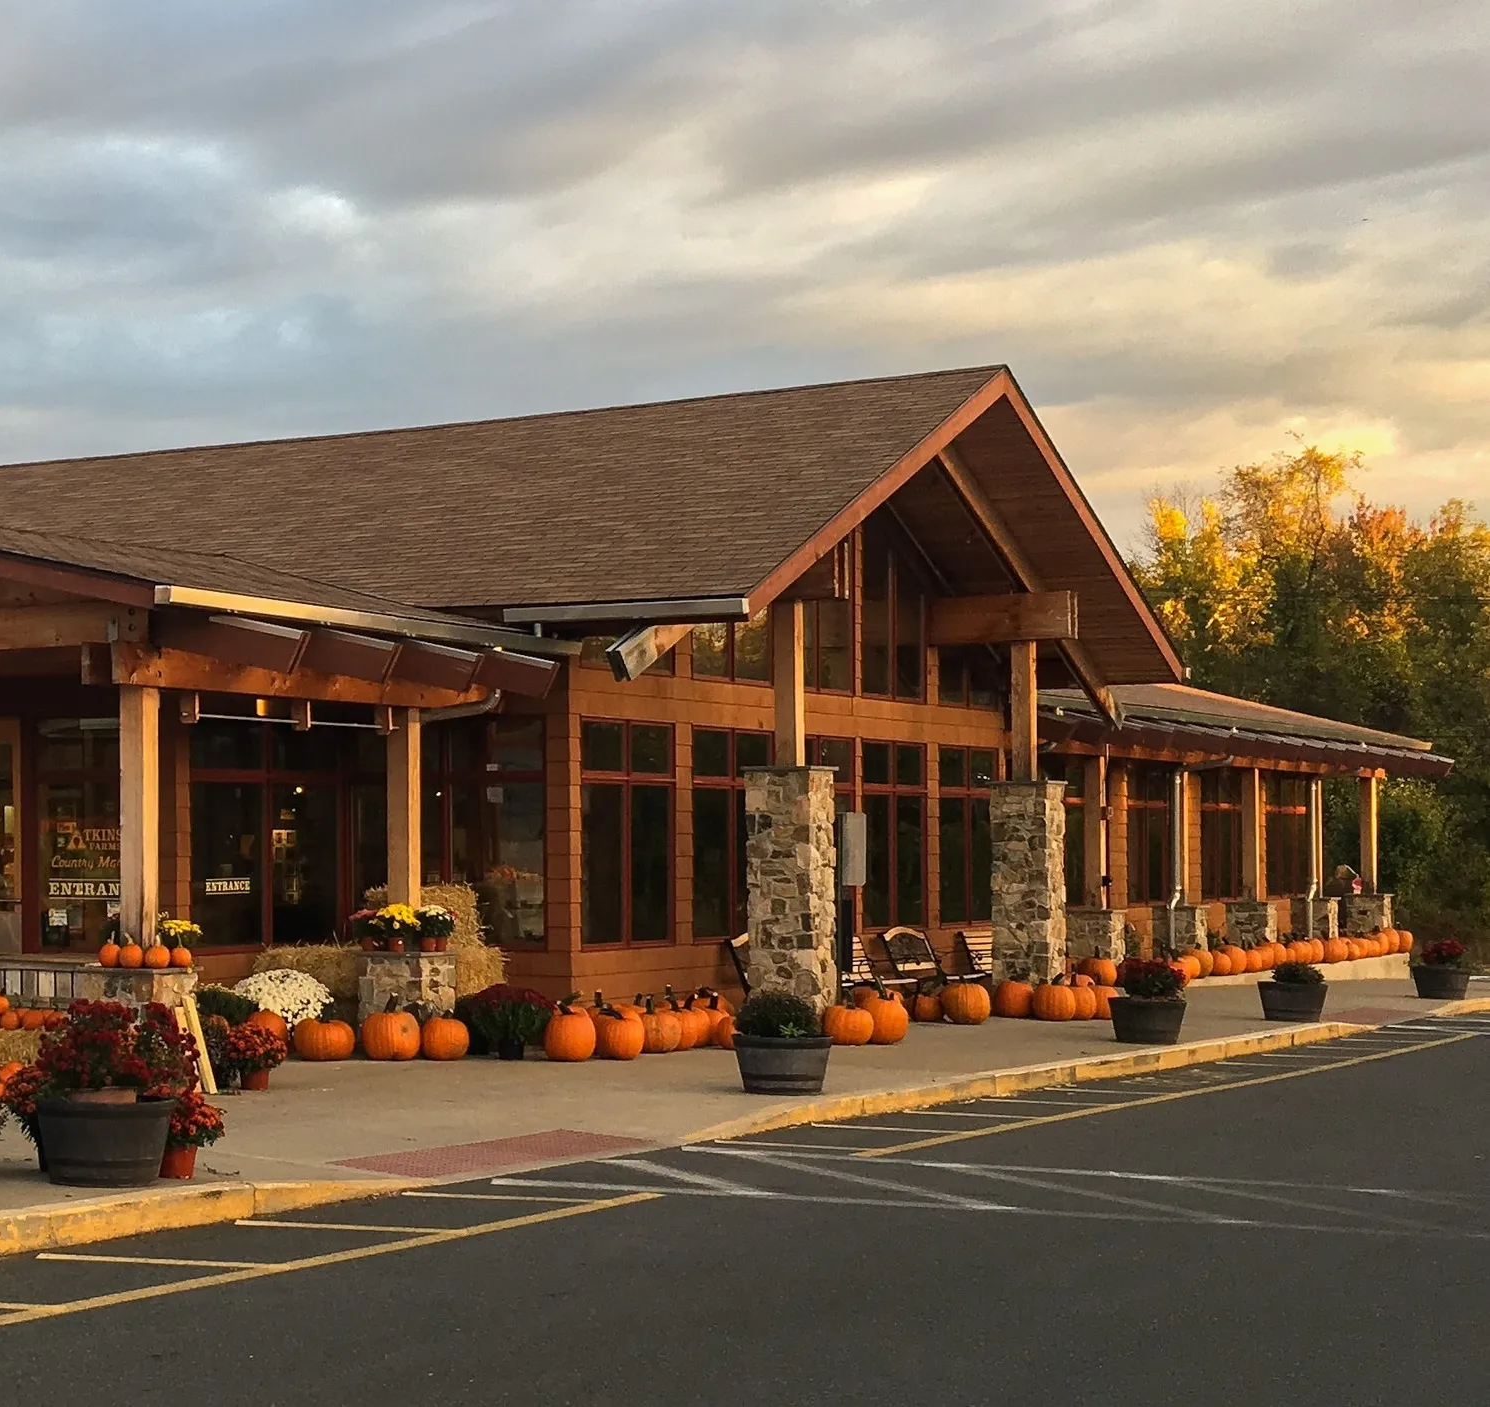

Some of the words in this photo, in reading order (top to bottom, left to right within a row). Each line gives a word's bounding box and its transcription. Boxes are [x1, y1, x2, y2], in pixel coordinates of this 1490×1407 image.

[51, 855, 94, 870] Country
[48, 882, 121, 896] ENTRAN
[205, 880, 250, 892] ENTRANCE
